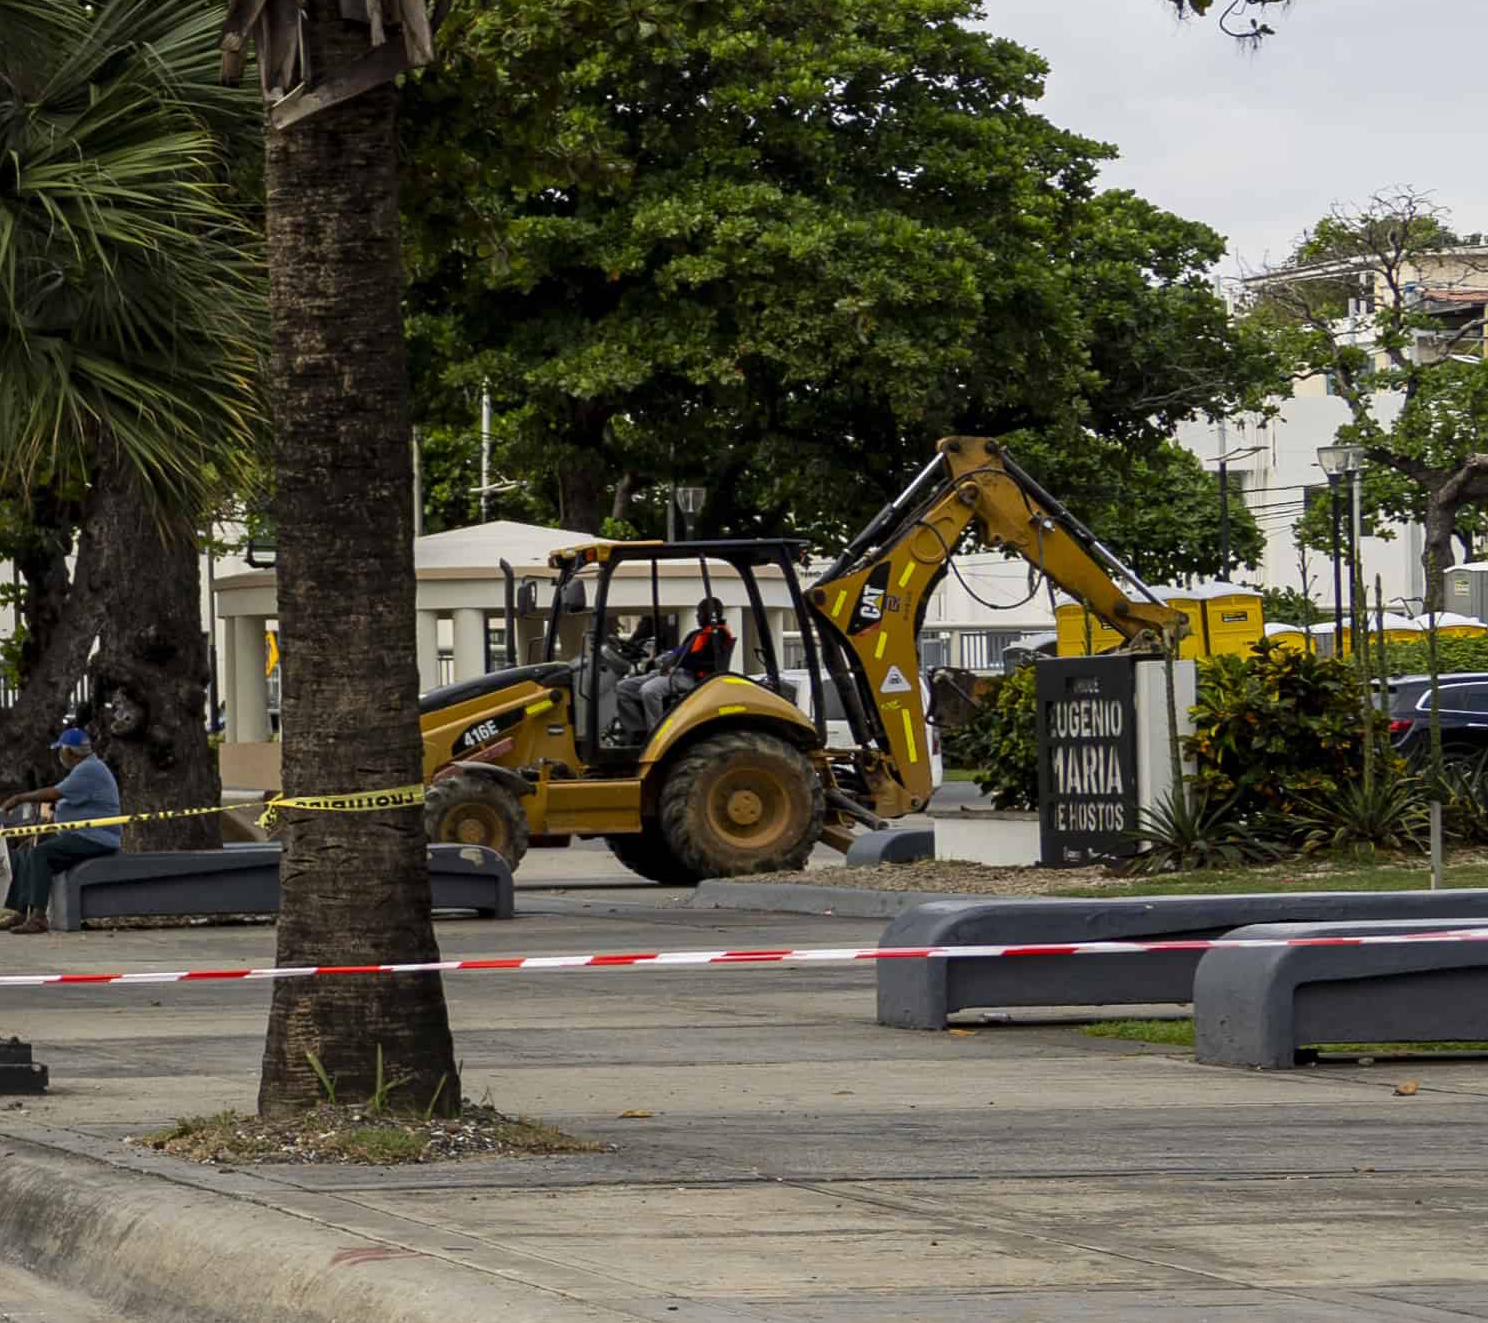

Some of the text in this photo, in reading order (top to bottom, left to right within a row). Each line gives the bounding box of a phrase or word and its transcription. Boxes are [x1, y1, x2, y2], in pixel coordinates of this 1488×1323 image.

[860, 584, 885, 619] CAT
[464, 720, 499, 746] 416E
[1051, 701, 1123, 738] UGENIO
[1055, 803, 1124, 831] E HOSTOS
